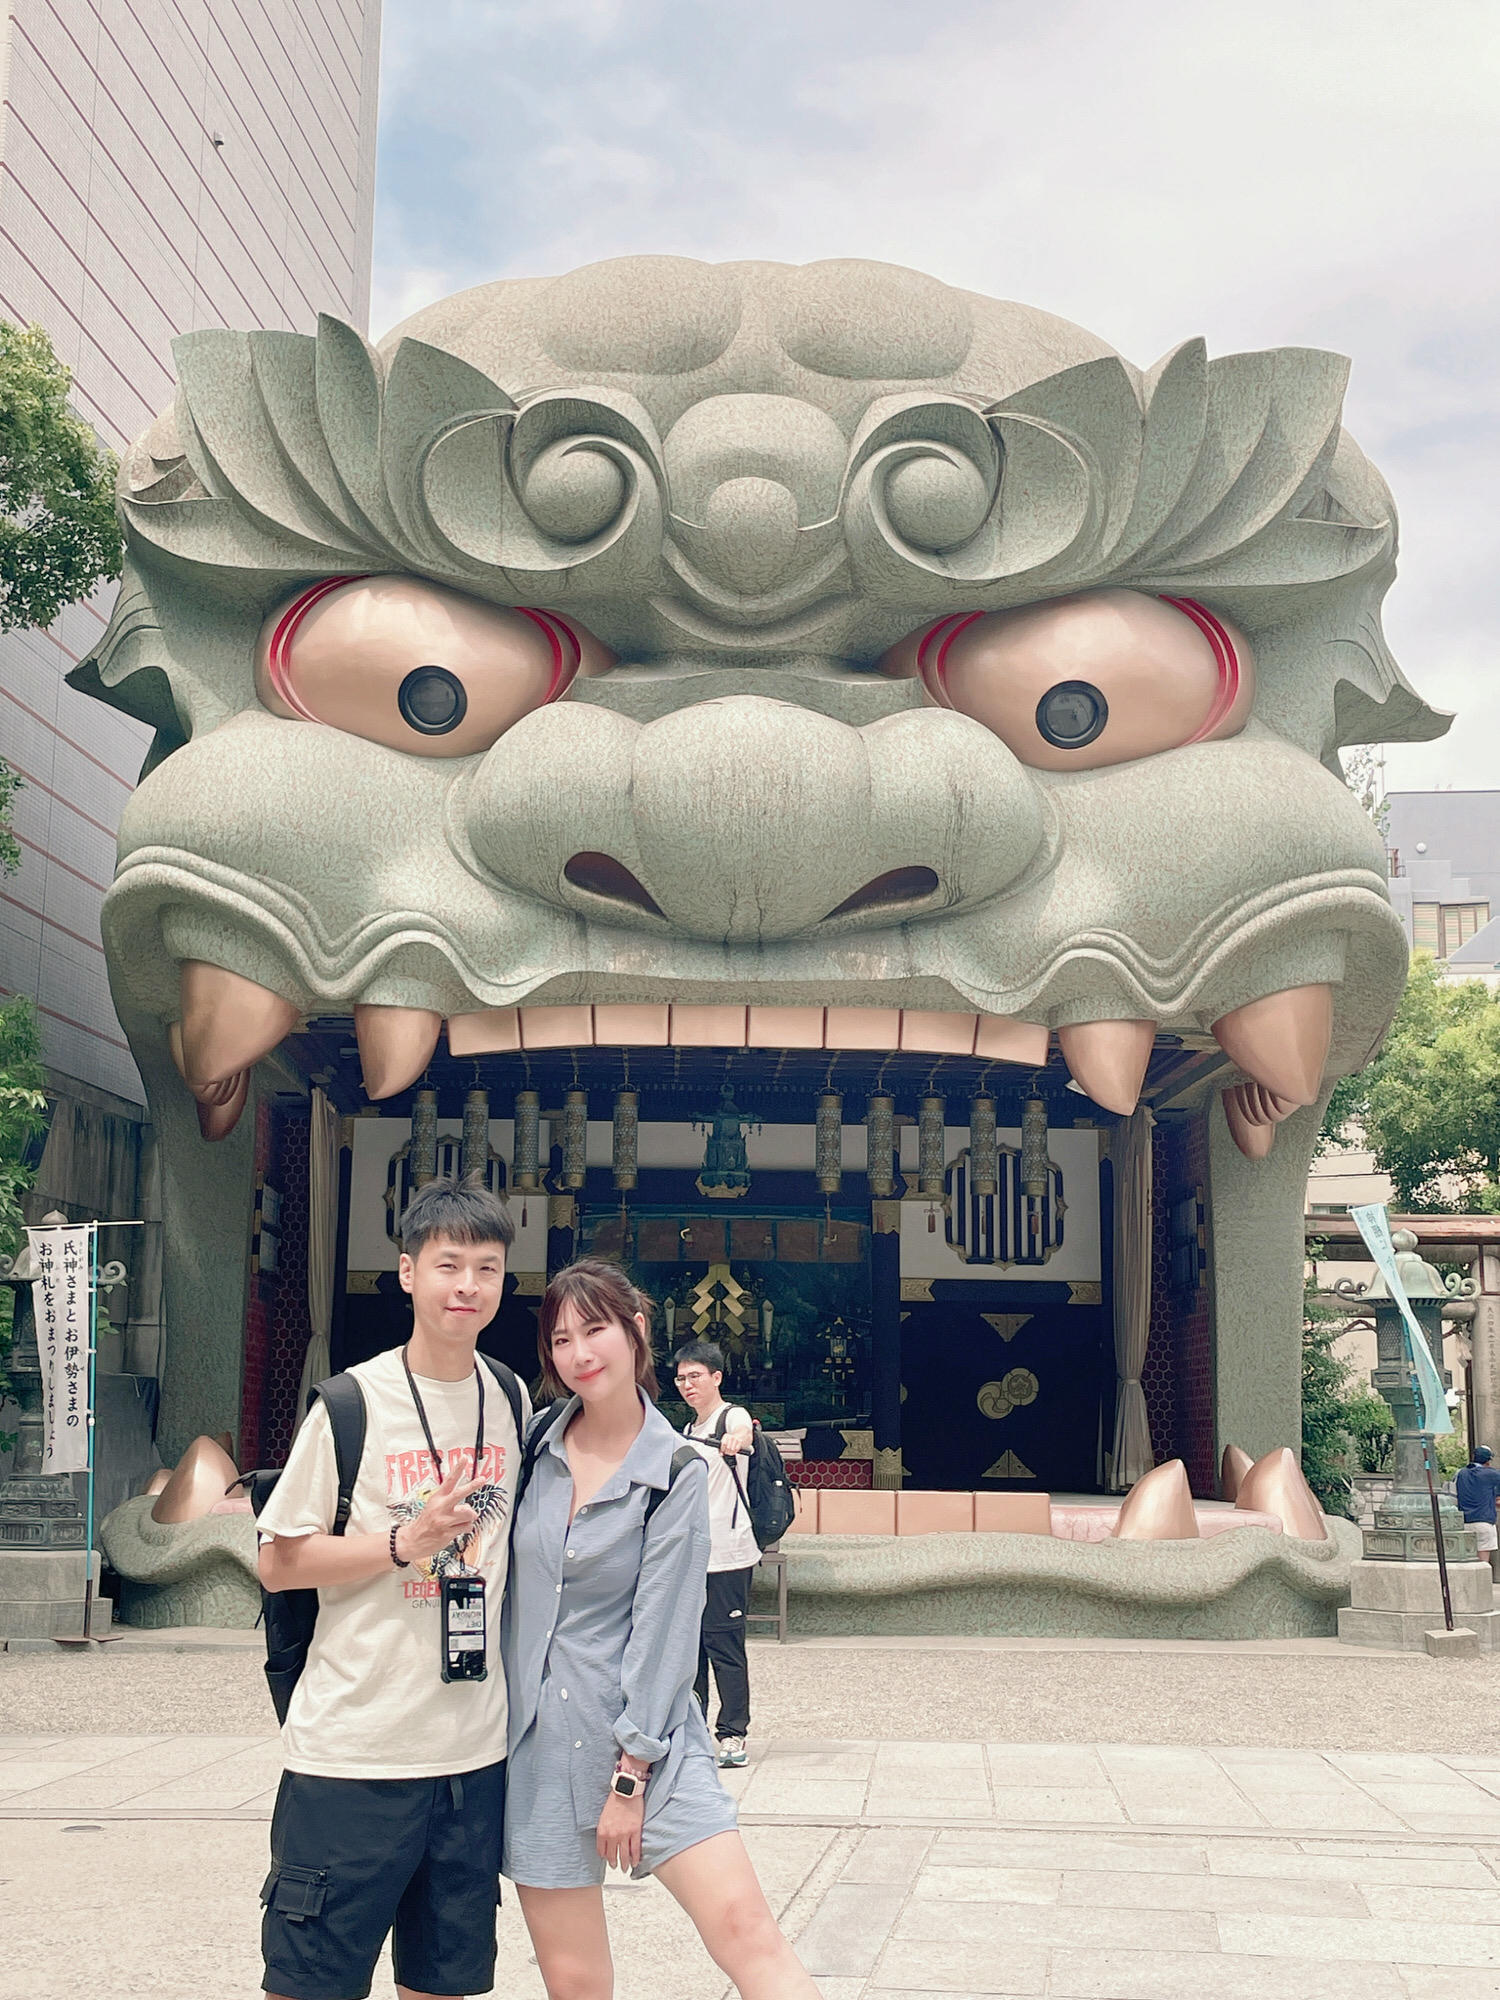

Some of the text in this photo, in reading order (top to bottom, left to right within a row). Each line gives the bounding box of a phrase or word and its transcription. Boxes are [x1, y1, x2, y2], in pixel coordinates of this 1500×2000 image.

[38, 1242, 56, 1459] お神札をおまつりしましょう
[63, 1240, 79, 1427] 氏神さまとお伊勢さまの
